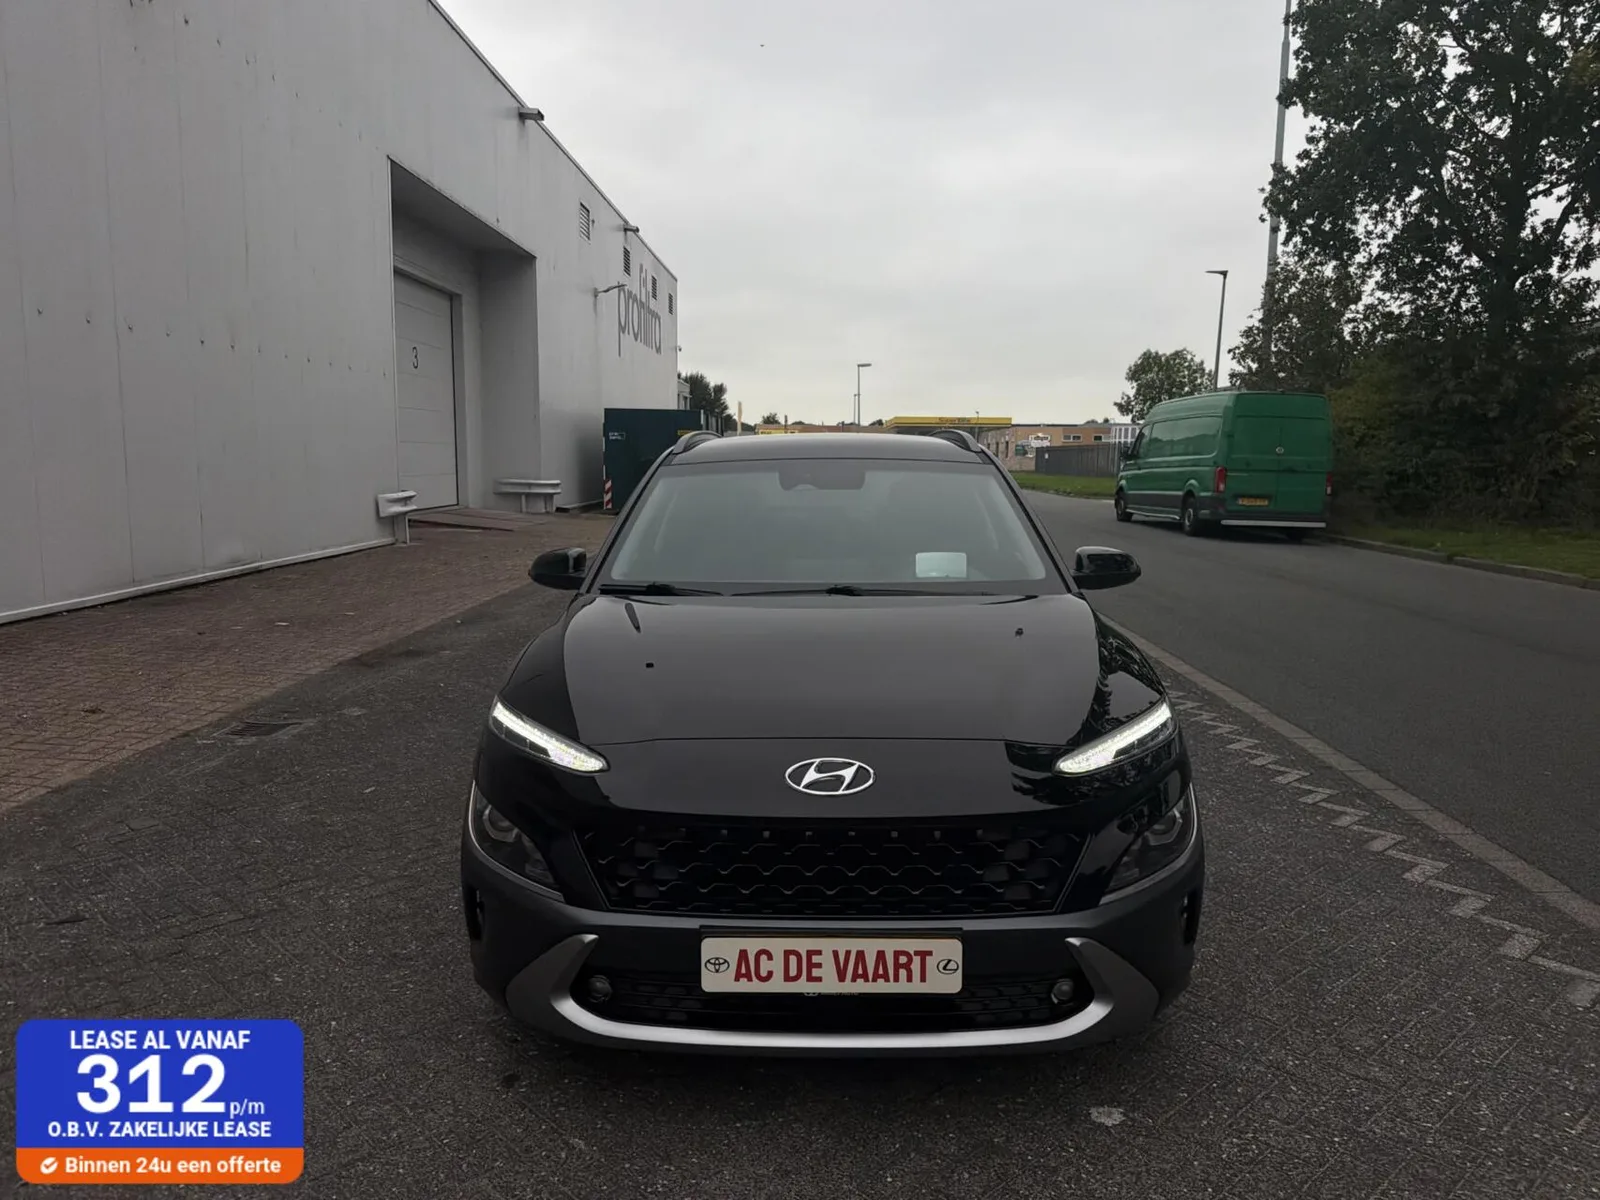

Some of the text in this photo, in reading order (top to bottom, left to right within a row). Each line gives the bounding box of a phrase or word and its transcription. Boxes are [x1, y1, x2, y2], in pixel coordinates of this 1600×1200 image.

[617, 262, 662, 358] profiltra
[412, 346, 419, 369] 3
[733, 948, 933, 983] AC DE VAART
